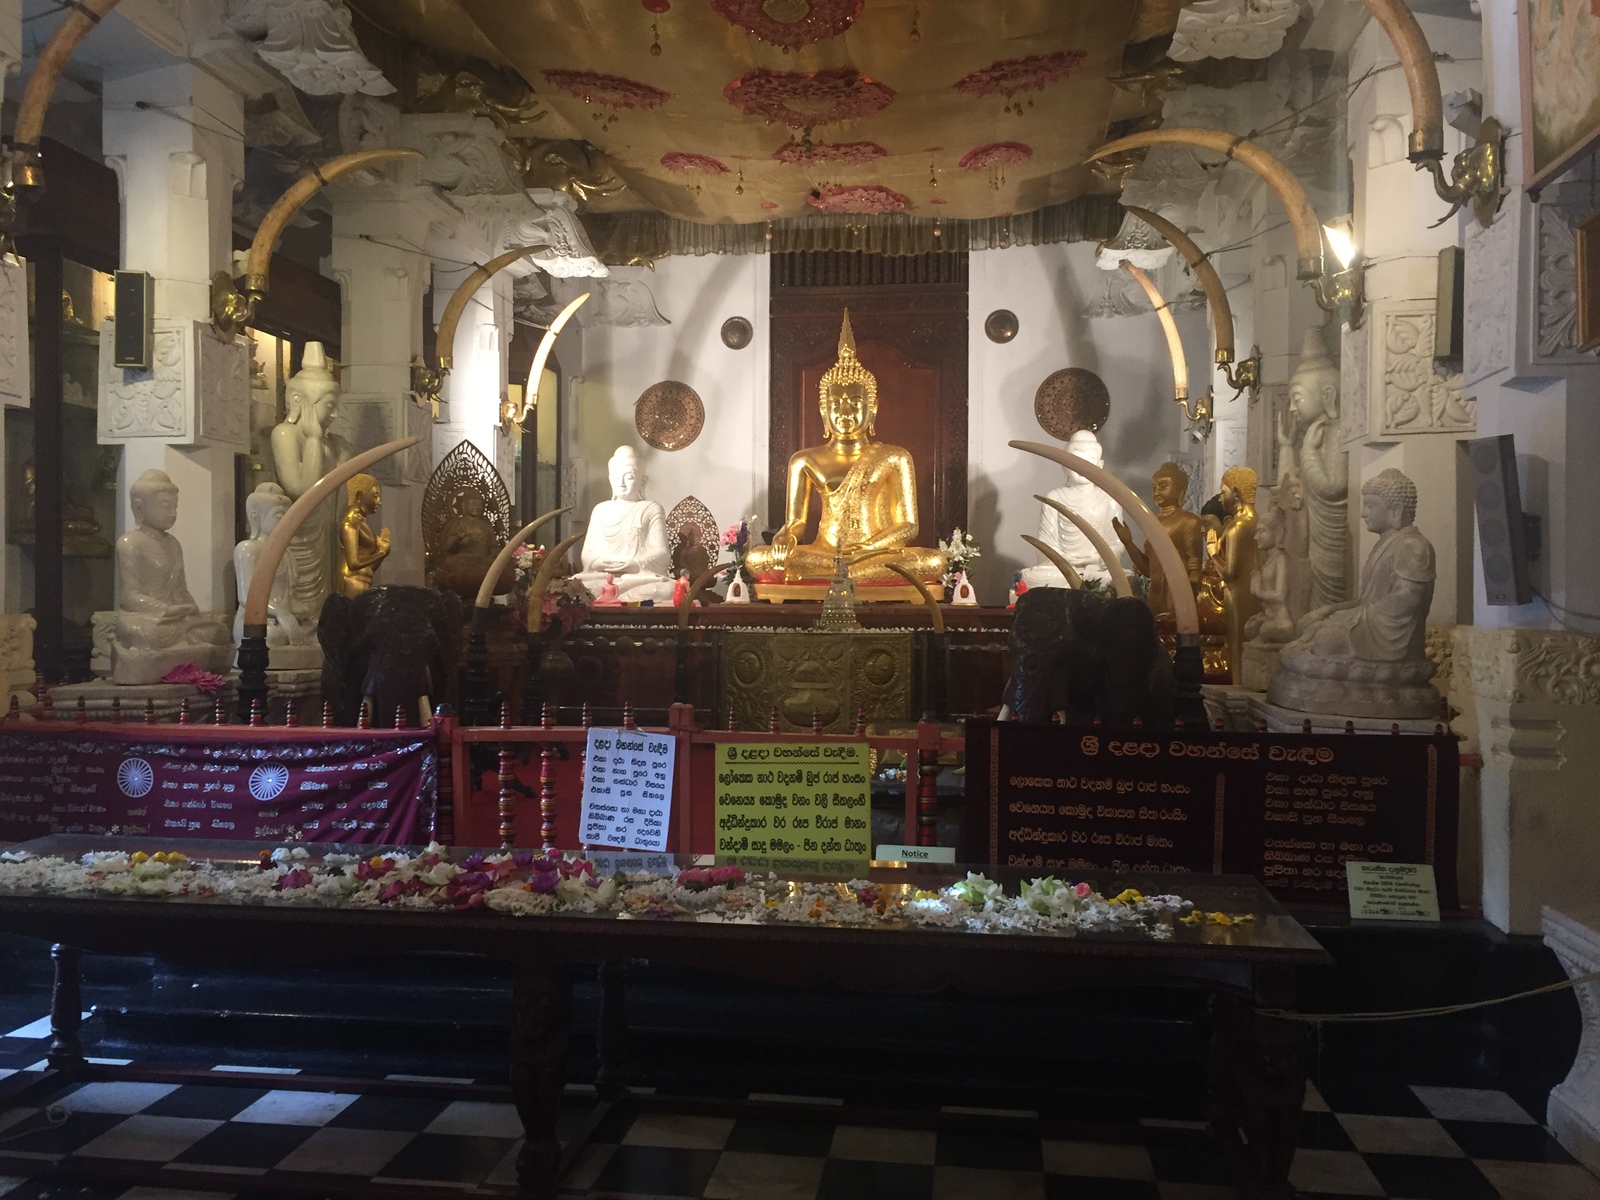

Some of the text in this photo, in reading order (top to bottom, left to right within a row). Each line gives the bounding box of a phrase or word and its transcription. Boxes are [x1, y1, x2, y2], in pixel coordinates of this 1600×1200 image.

[594, 739, 611, 751] දළදා
[616, 739, 644, 751] වහන්සේ
[741, 748, 770, 760] දළදා
[773, 746, 820, 758] වහන්සේ
[1107, 740, 1160, 759] දළදා
[1169, 740, 1260, 760] වහන්සේ
[1268, 745, 1334, 766] වැඳීම
[823, 771, 839, 784] රාජ
[1137, 780, 1157, 793] රාජ
[773, 815, 786, 829] වර
[1071, 830, 1088, 843] වර
[901, 849, 929, 858] Notice
